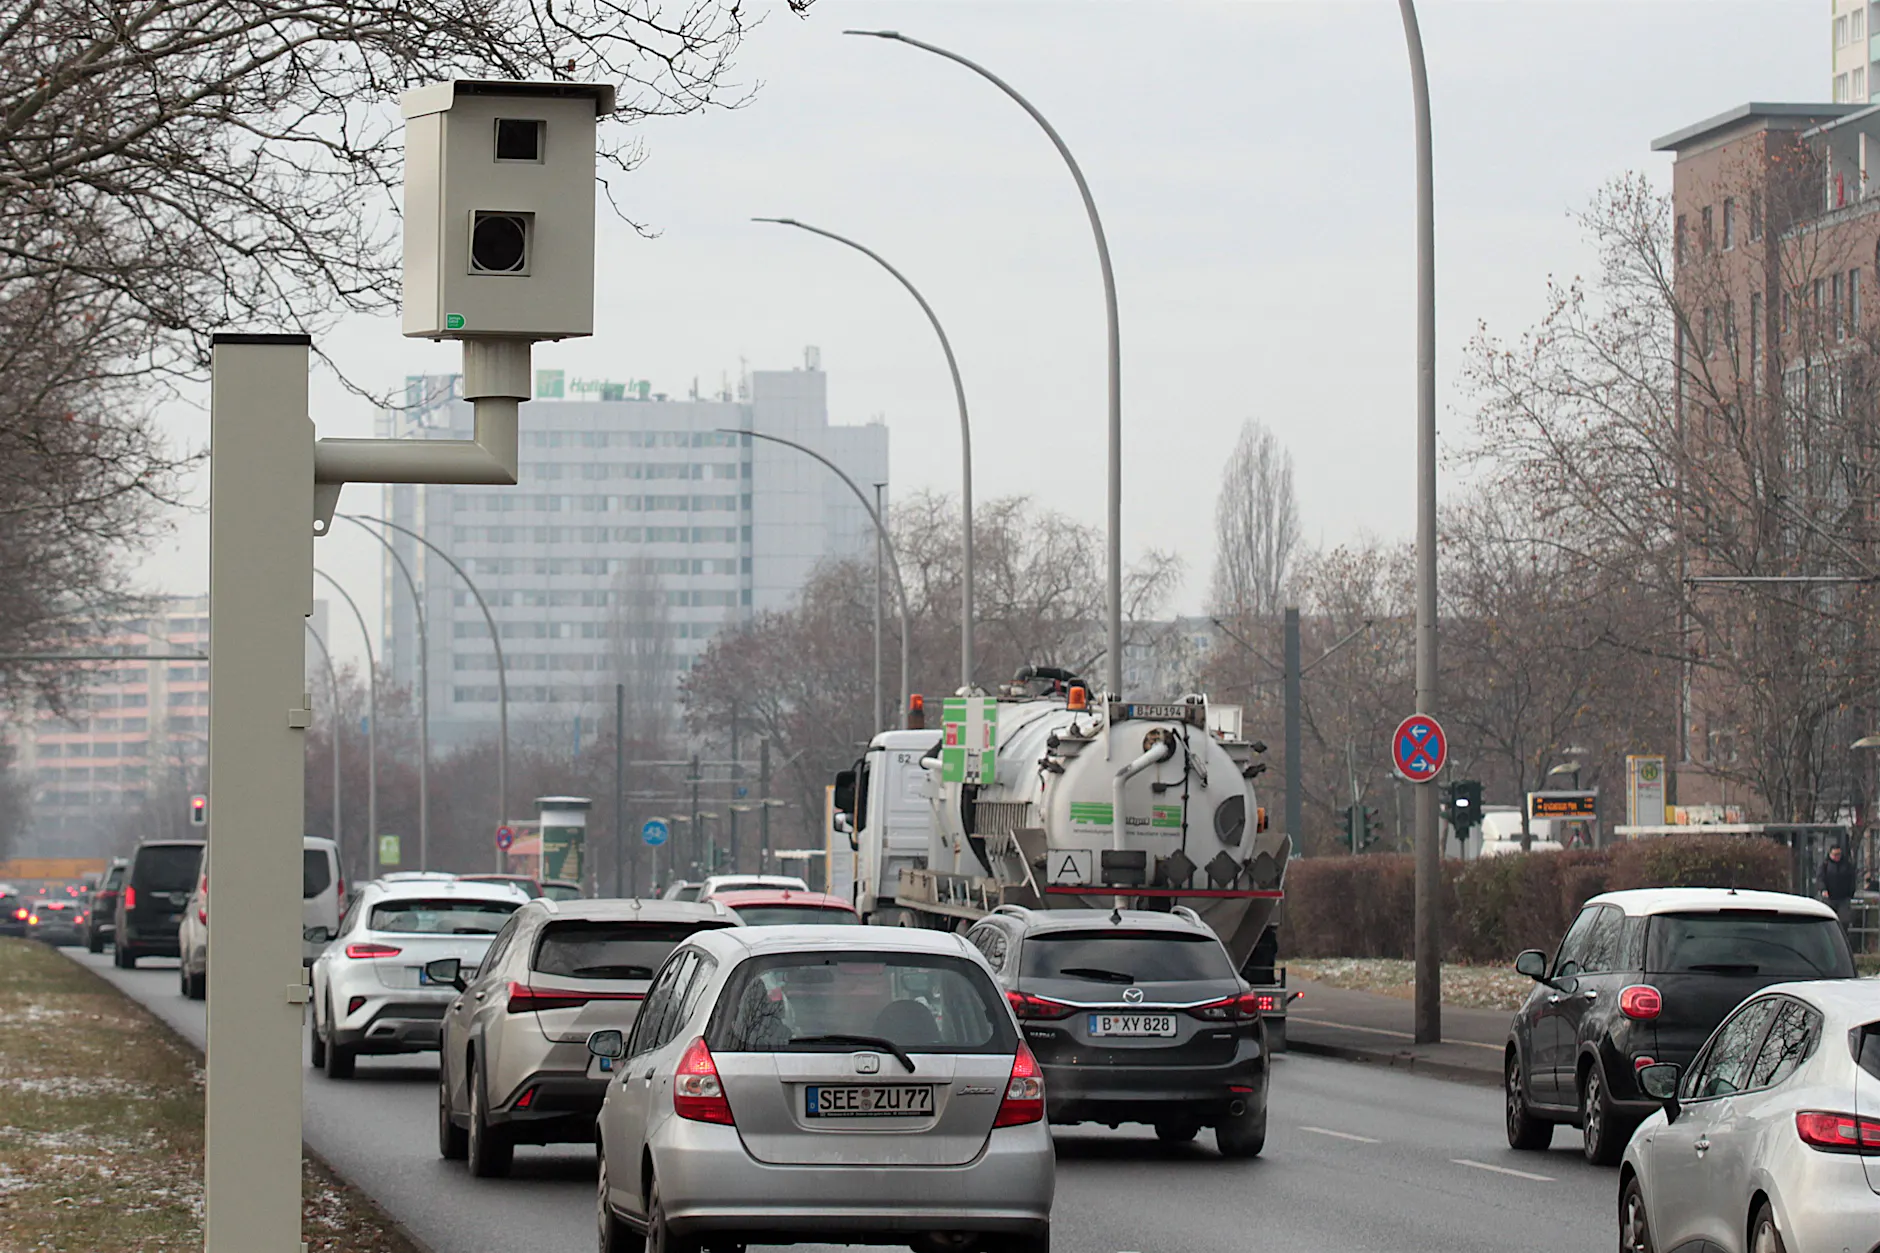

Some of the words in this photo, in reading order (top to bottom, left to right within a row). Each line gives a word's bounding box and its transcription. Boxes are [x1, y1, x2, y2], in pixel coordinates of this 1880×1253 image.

[1057, 855, 1081, 878] A
[1102, 1017, 1112, 1031] B
[1122, 1017, 1140, 1031] XY
[1143, 1017, 1170, 1031] 828
[819, 1089, 860, 1110] SEE
[873, 1088, 900, 1109] ZU
[904, 1088, 930, 1109] 77
